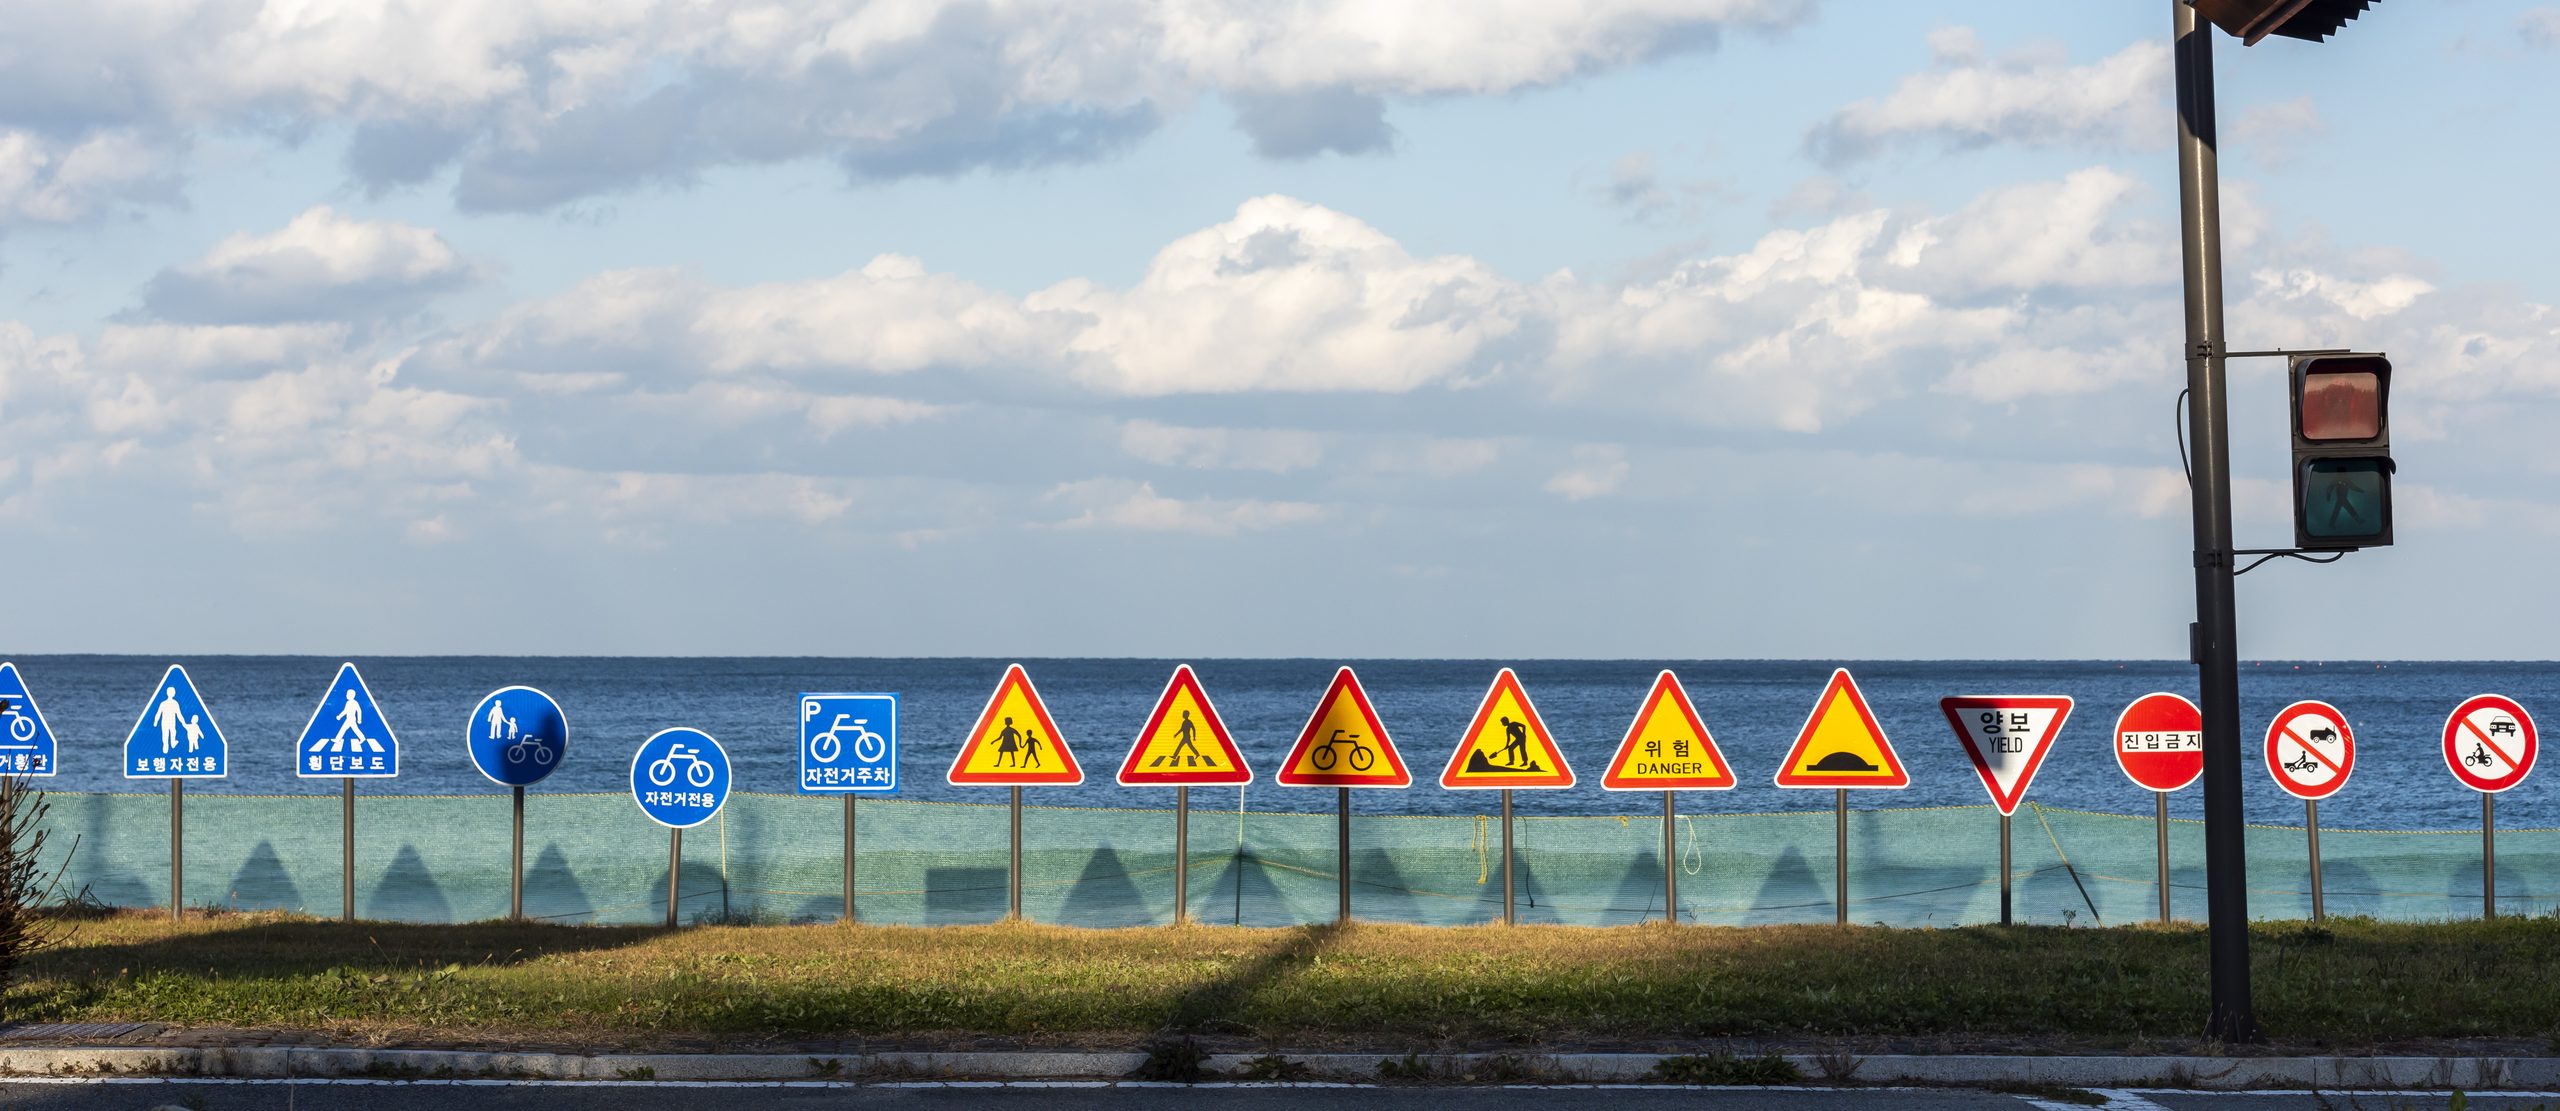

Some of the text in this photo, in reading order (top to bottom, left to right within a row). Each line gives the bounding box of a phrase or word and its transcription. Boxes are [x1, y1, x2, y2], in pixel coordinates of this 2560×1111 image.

[805, 701, 821, 722] P
[1980, 711, 2030, 734] 양보
[1989, 737, 2023, 753] YIELD
[2125, 733, 2201, 749] 진입금지
[136, 757, 216, 772] 보행자전용
[308, 755, 385, 771] 횡단보도
[1637, 763, 1702, 774] DANGER
[806, 767, 890, 784] 자전거주차
[645, 791, 715, 808] 자전거전용
